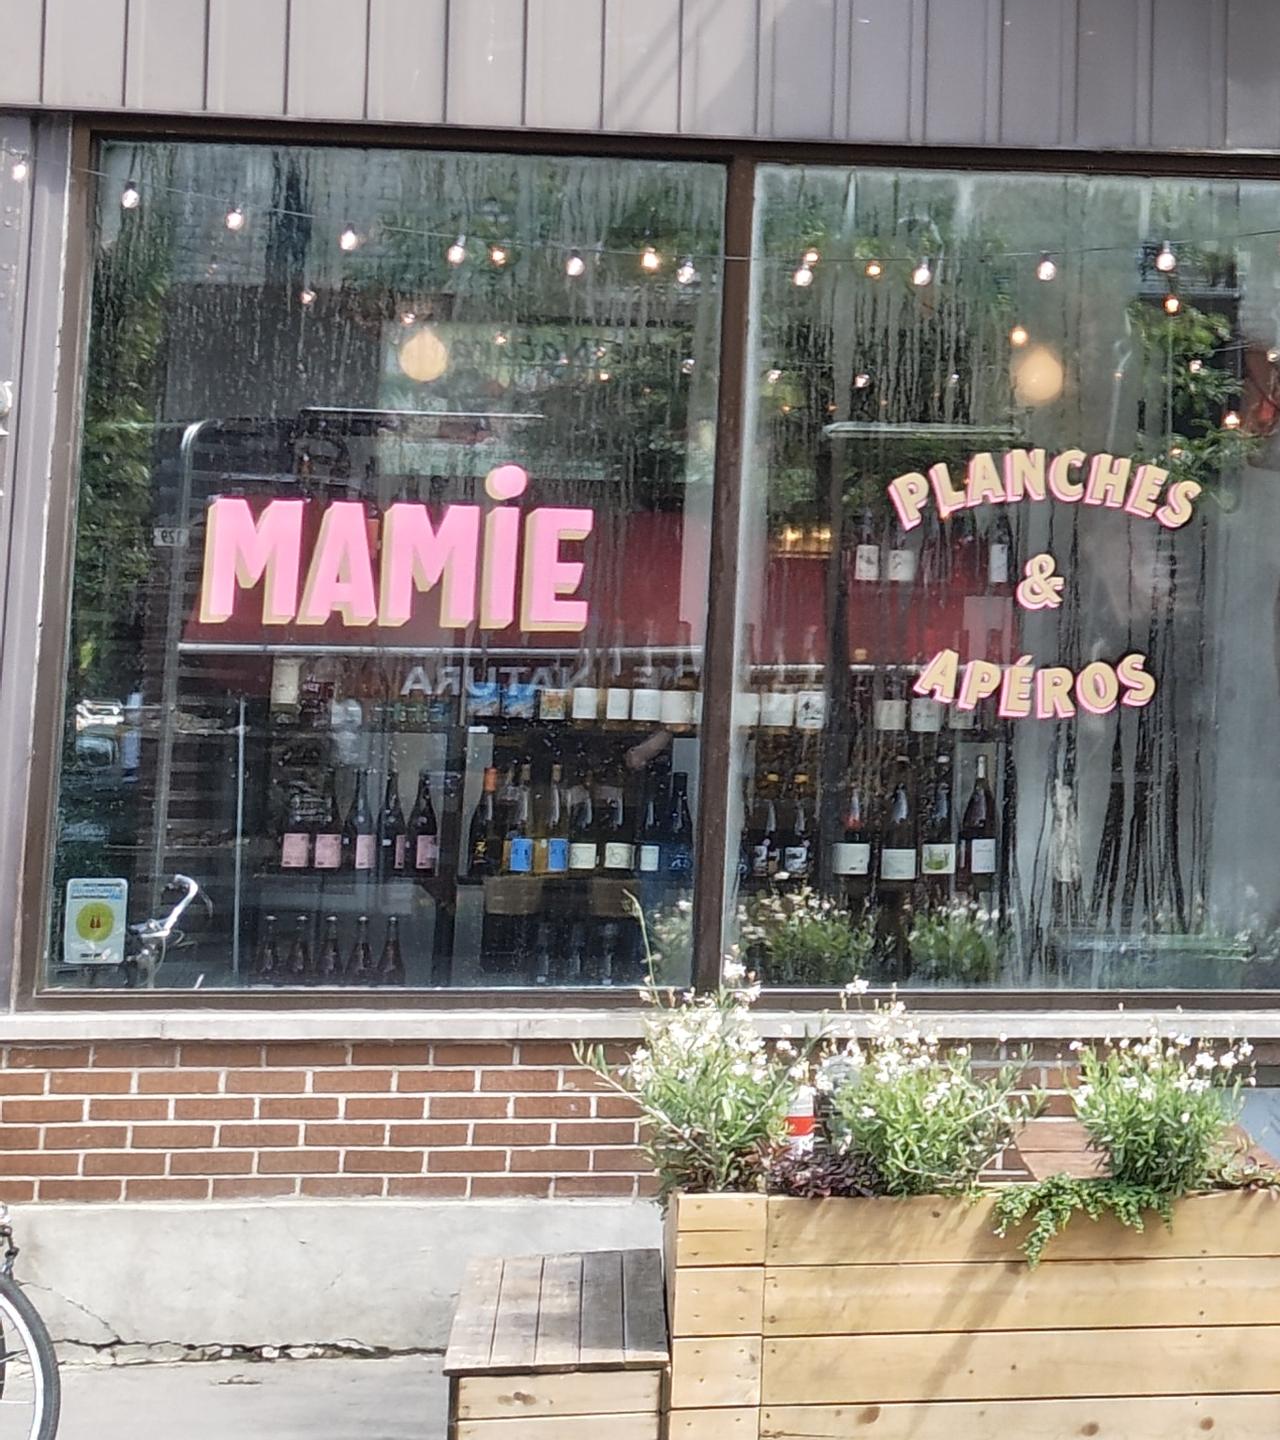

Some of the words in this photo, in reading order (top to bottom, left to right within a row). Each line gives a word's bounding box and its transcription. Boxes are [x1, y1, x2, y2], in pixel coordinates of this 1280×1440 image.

[888, 447, 1203, 531] PLANCHES
[1015, 552, 1066, 610] &
[913, 648, 1157, 720] APÉROS
